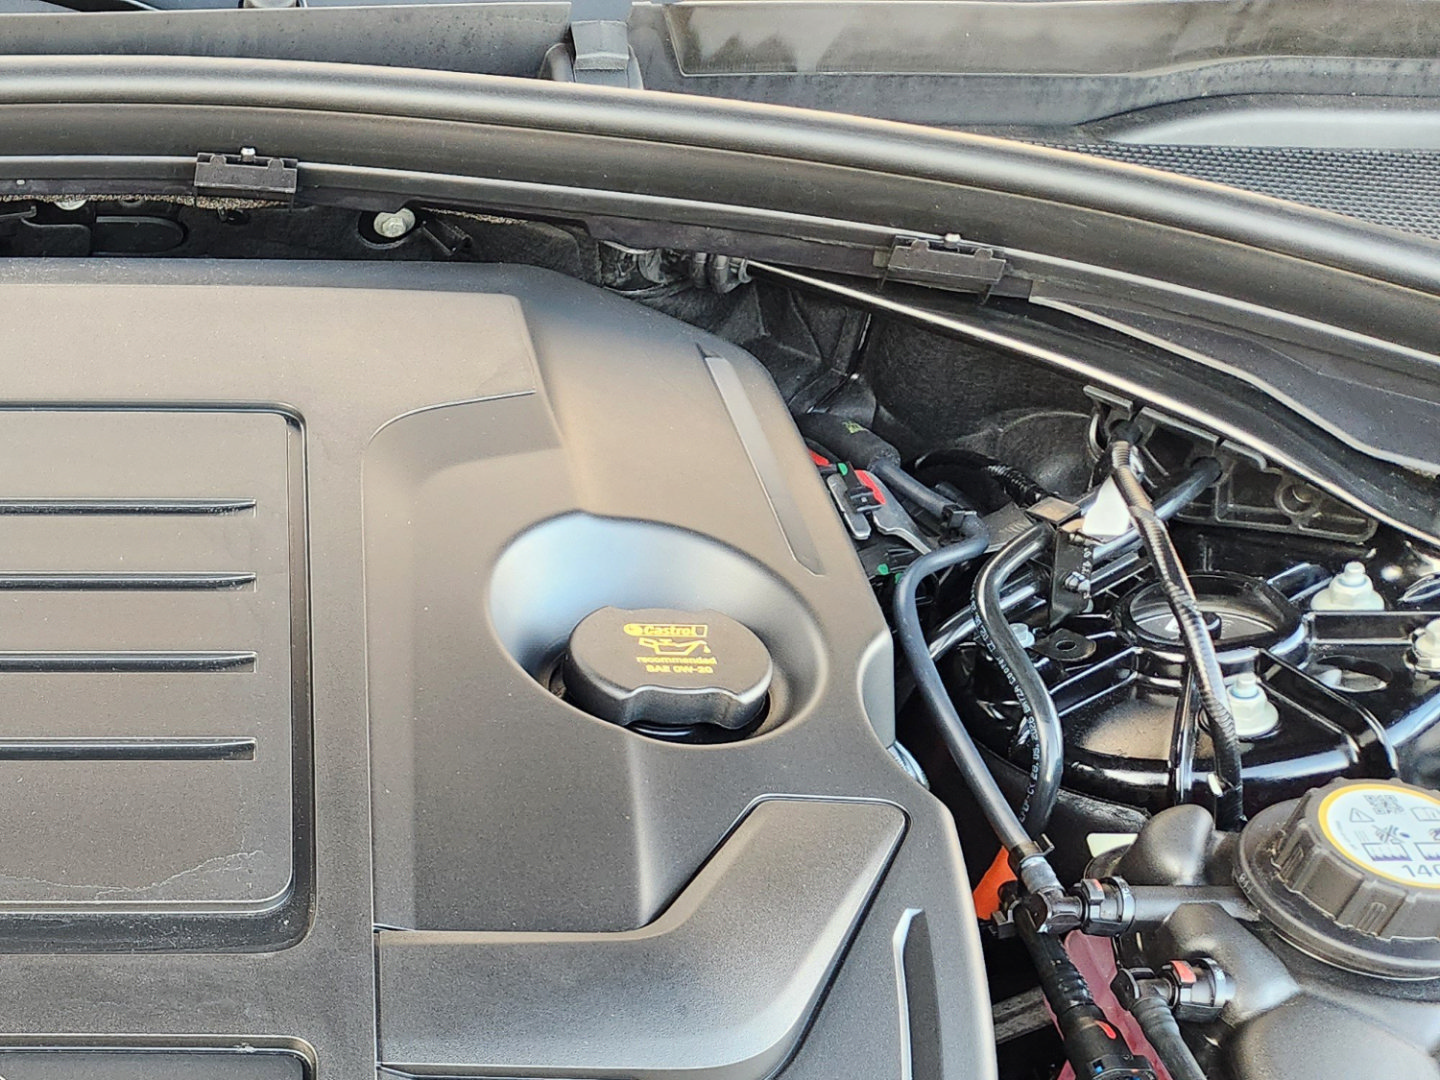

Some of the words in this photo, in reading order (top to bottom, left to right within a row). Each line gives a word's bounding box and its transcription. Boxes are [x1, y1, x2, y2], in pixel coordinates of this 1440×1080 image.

[644, 625, 696, 636] Castrol
[636, 656, 717, 665] recommended
[646, 665, 671, 673] SAE
[673, 665, 714, 674] 0W-20
